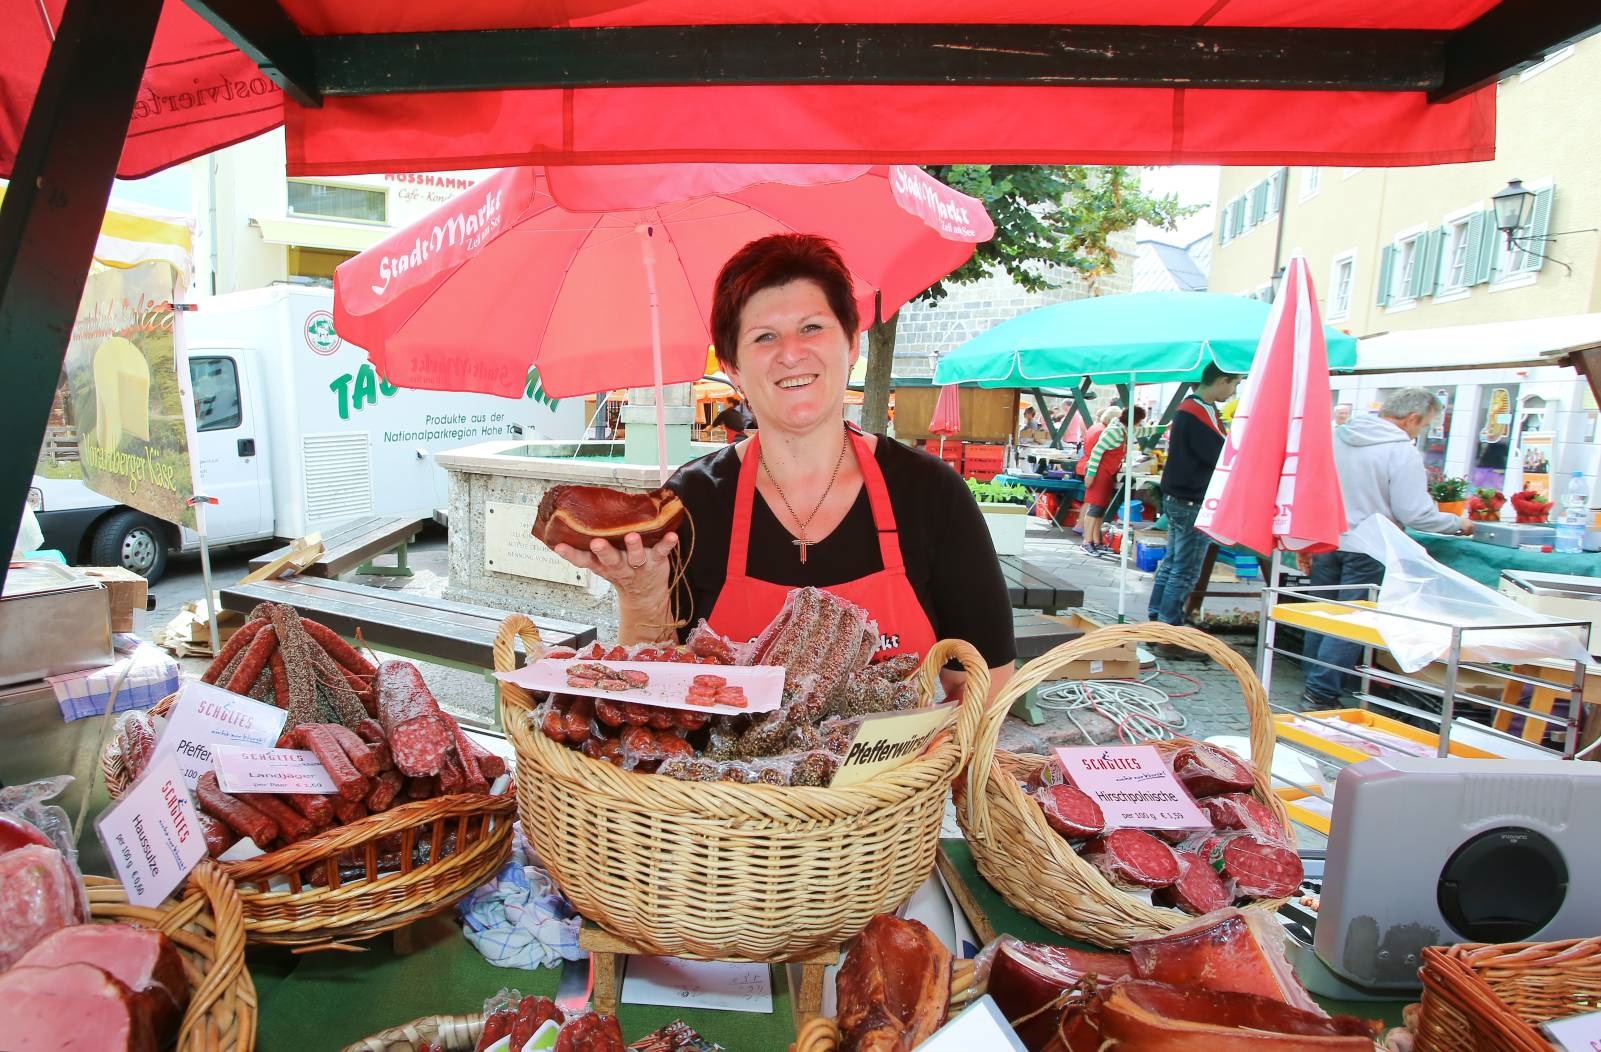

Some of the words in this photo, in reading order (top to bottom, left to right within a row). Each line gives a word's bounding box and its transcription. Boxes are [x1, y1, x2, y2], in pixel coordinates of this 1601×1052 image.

[425, 413, 467, 426] Produkte
[471, 414, 486, 424] aus
[490, 412, 505, 422] der
[384, 427, 477, 443] Nationalparkregion
[481, 425, 503, 436] Hohe
[176, 738, 213, 763] Pfeffer
[183, 768, 199, 779] 100
[1095, 790, 1179, 805] Hirschpolnische
[1121, 812, 1134, 820] per
[1149, 813, 1156, 821] g
[115, 833, 125, 847] per
[132, 814, 160, 878] Haussulze
[121, 846, 132, 862] 100
[126, 861, 134, 869] g
[131, 870, 139, 879] €
